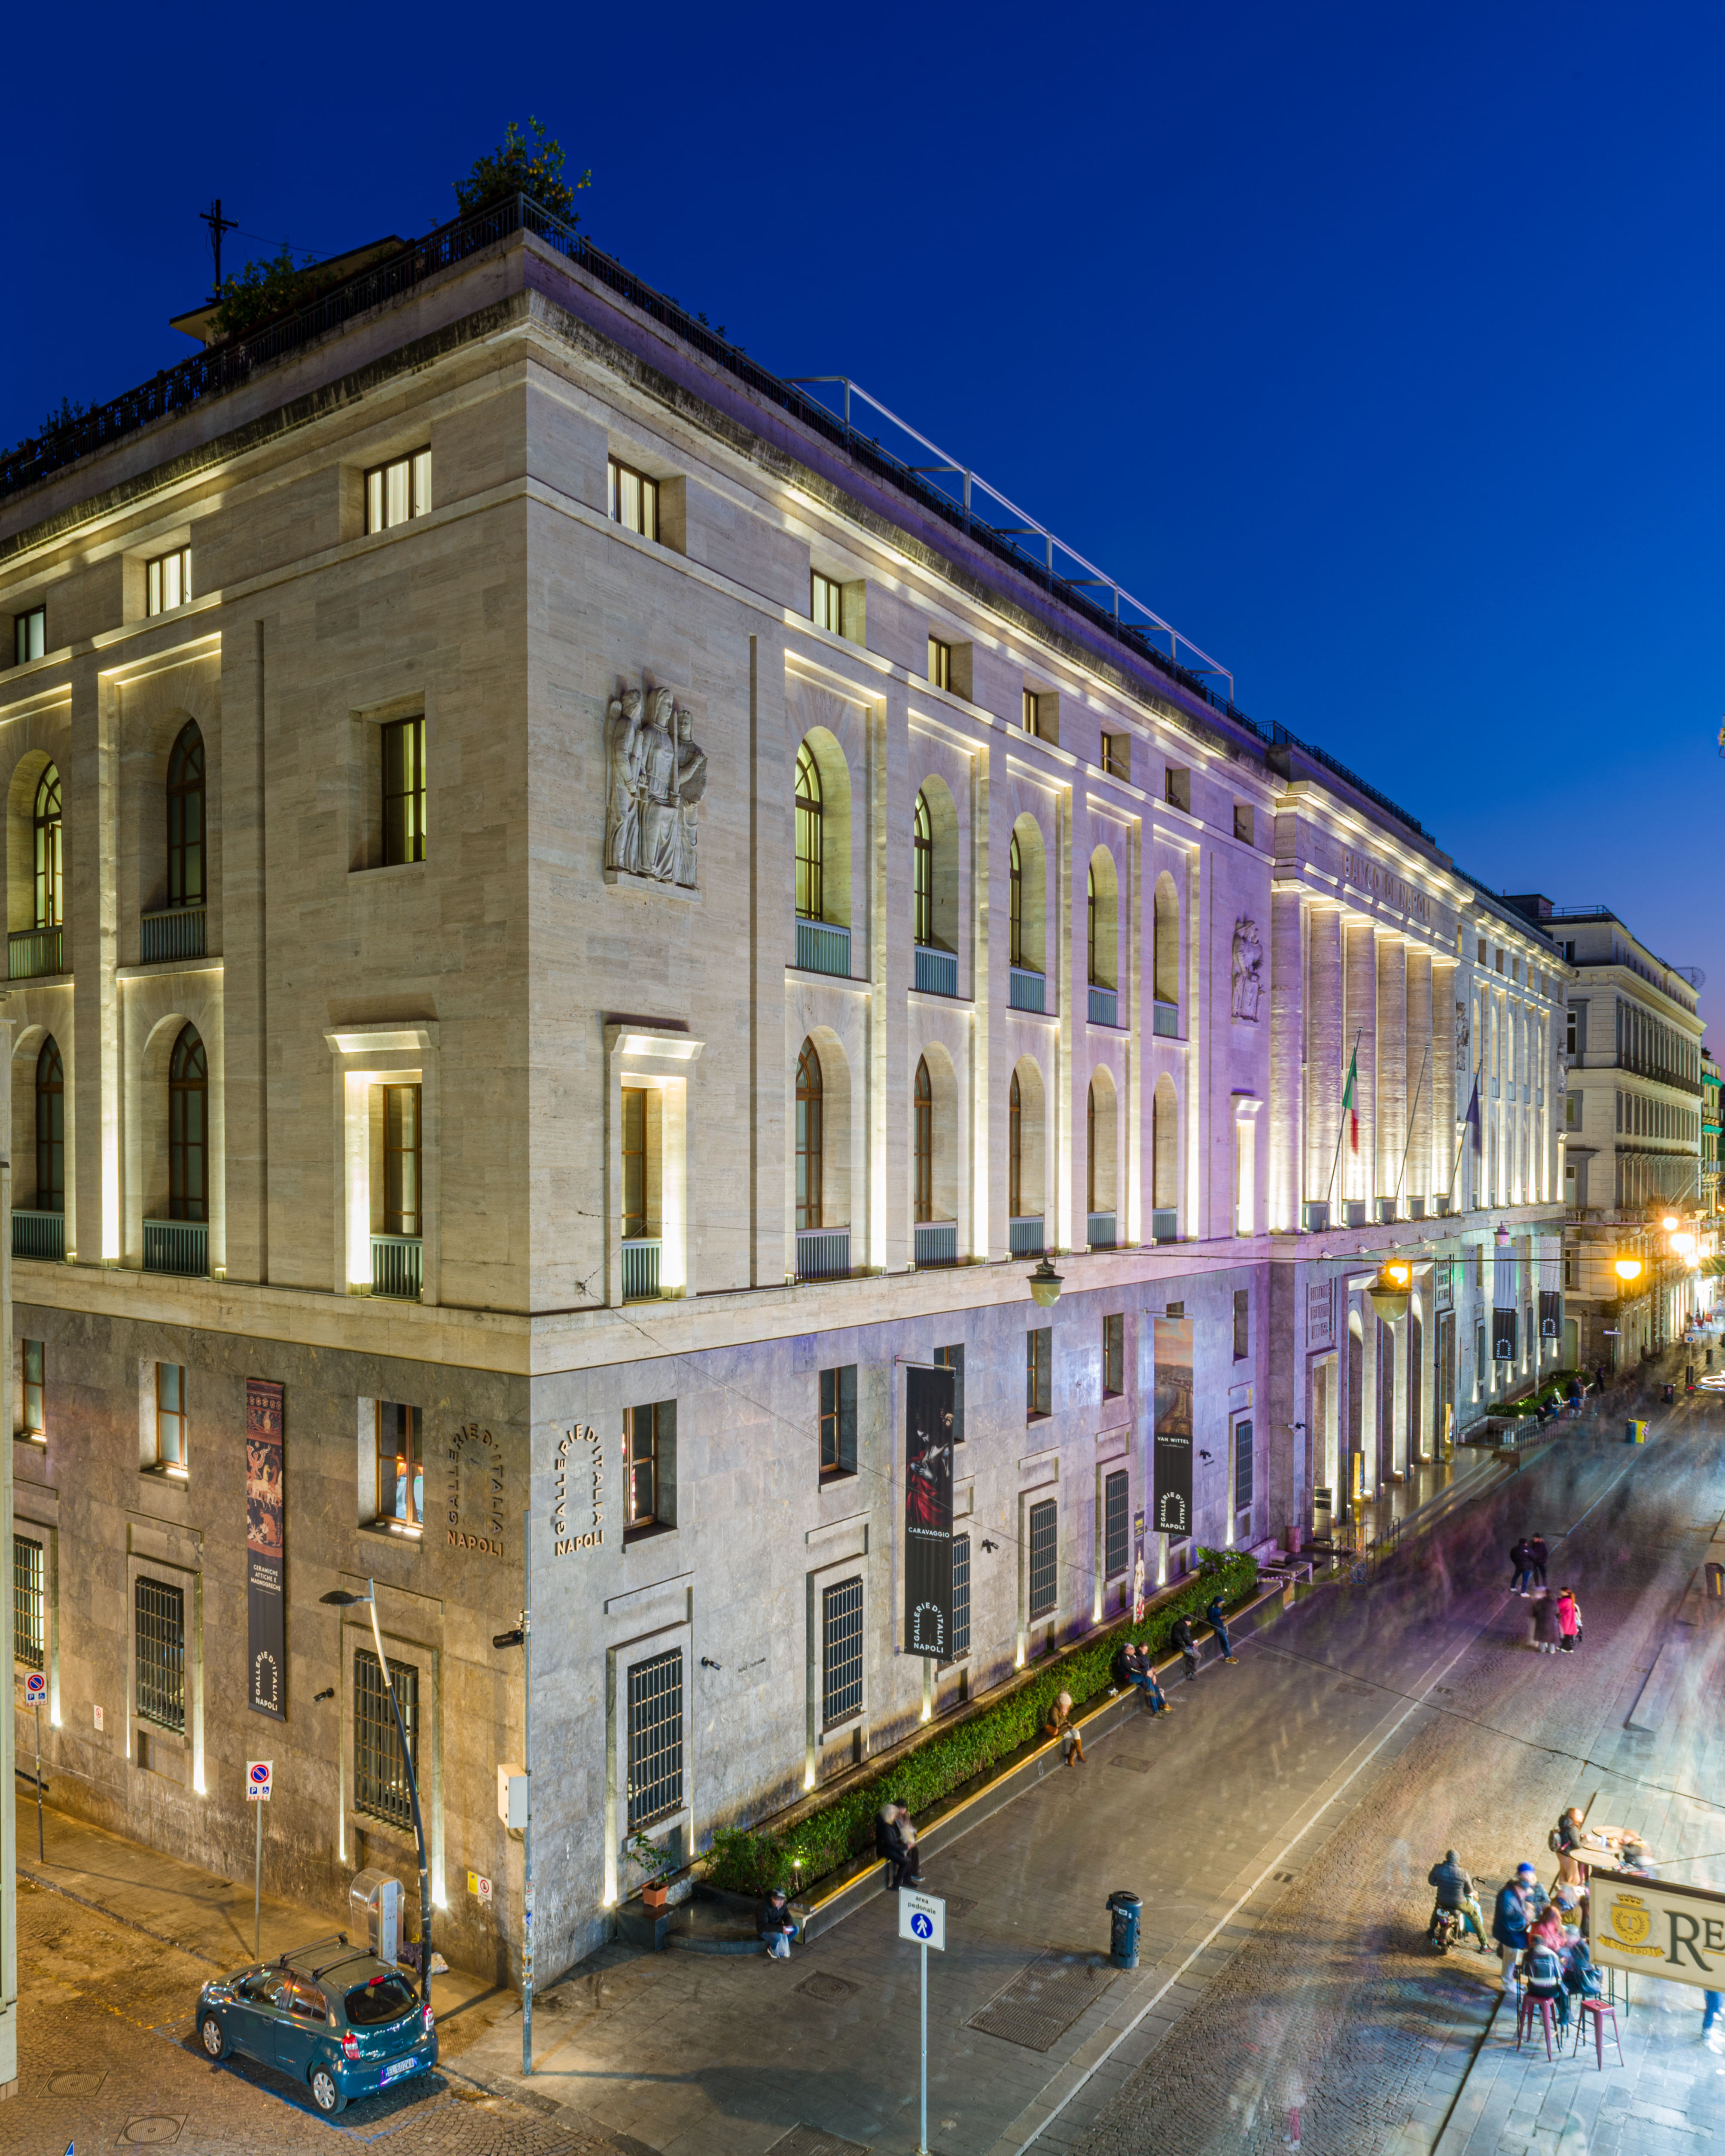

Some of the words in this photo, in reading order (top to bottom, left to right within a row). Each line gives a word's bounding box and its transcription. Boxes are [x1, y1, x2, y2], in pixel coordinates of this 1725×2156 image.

[1342, 848, 1379, 891] BANCO
[1385, 874, 1394, 901] DI
[1399, 882, 1430, 922] NAPOLI
[1496, 1339, 1505, 1355] GALLERIE
[448, 1423, 478, 1525] GALLERIE
[480, 1430, 503, 1534] D'ITALIA
[555, 1424, 583, 1536] GALLERIE
[585, 1426, 604, 1526] D'ITALIA
[1161, 1492, 1174, 1522] GALLERIE
[1175, 1494, 1185, 1524] D'ITALIA
[908, 1527, 950, 1538] CARAVAGGIO
[1161, 1522, 1185, 1530] NAPOLI
[447, 1530, 503, 1557] NAPOLI
[555, 1530, 604, 1556] NAPOLI
[253, 1564, 278, 1577] CERAMICHE
[255, 1572, 272, 1582] ATTICHE
[251, 1577, 281, 1591] MAGNOGRECHE
[914, 1602, 930, 1641] GALLERIE
[932, 1605, 943, 1645] D'ITALIA
[914, 1642, 943, 1654] NAPOLI
[256, 1651, 268, 1696] GALLERIE
[268, 1655, 277, 1701] D'ITALIA
[256, 1697, 277, 1711] NAPOLI
[908, 1902, 936, 1915] pedonale
[1613, 1942, 1648, 1955] TOLEDO
[388, 2067, 395, 2075] EL
